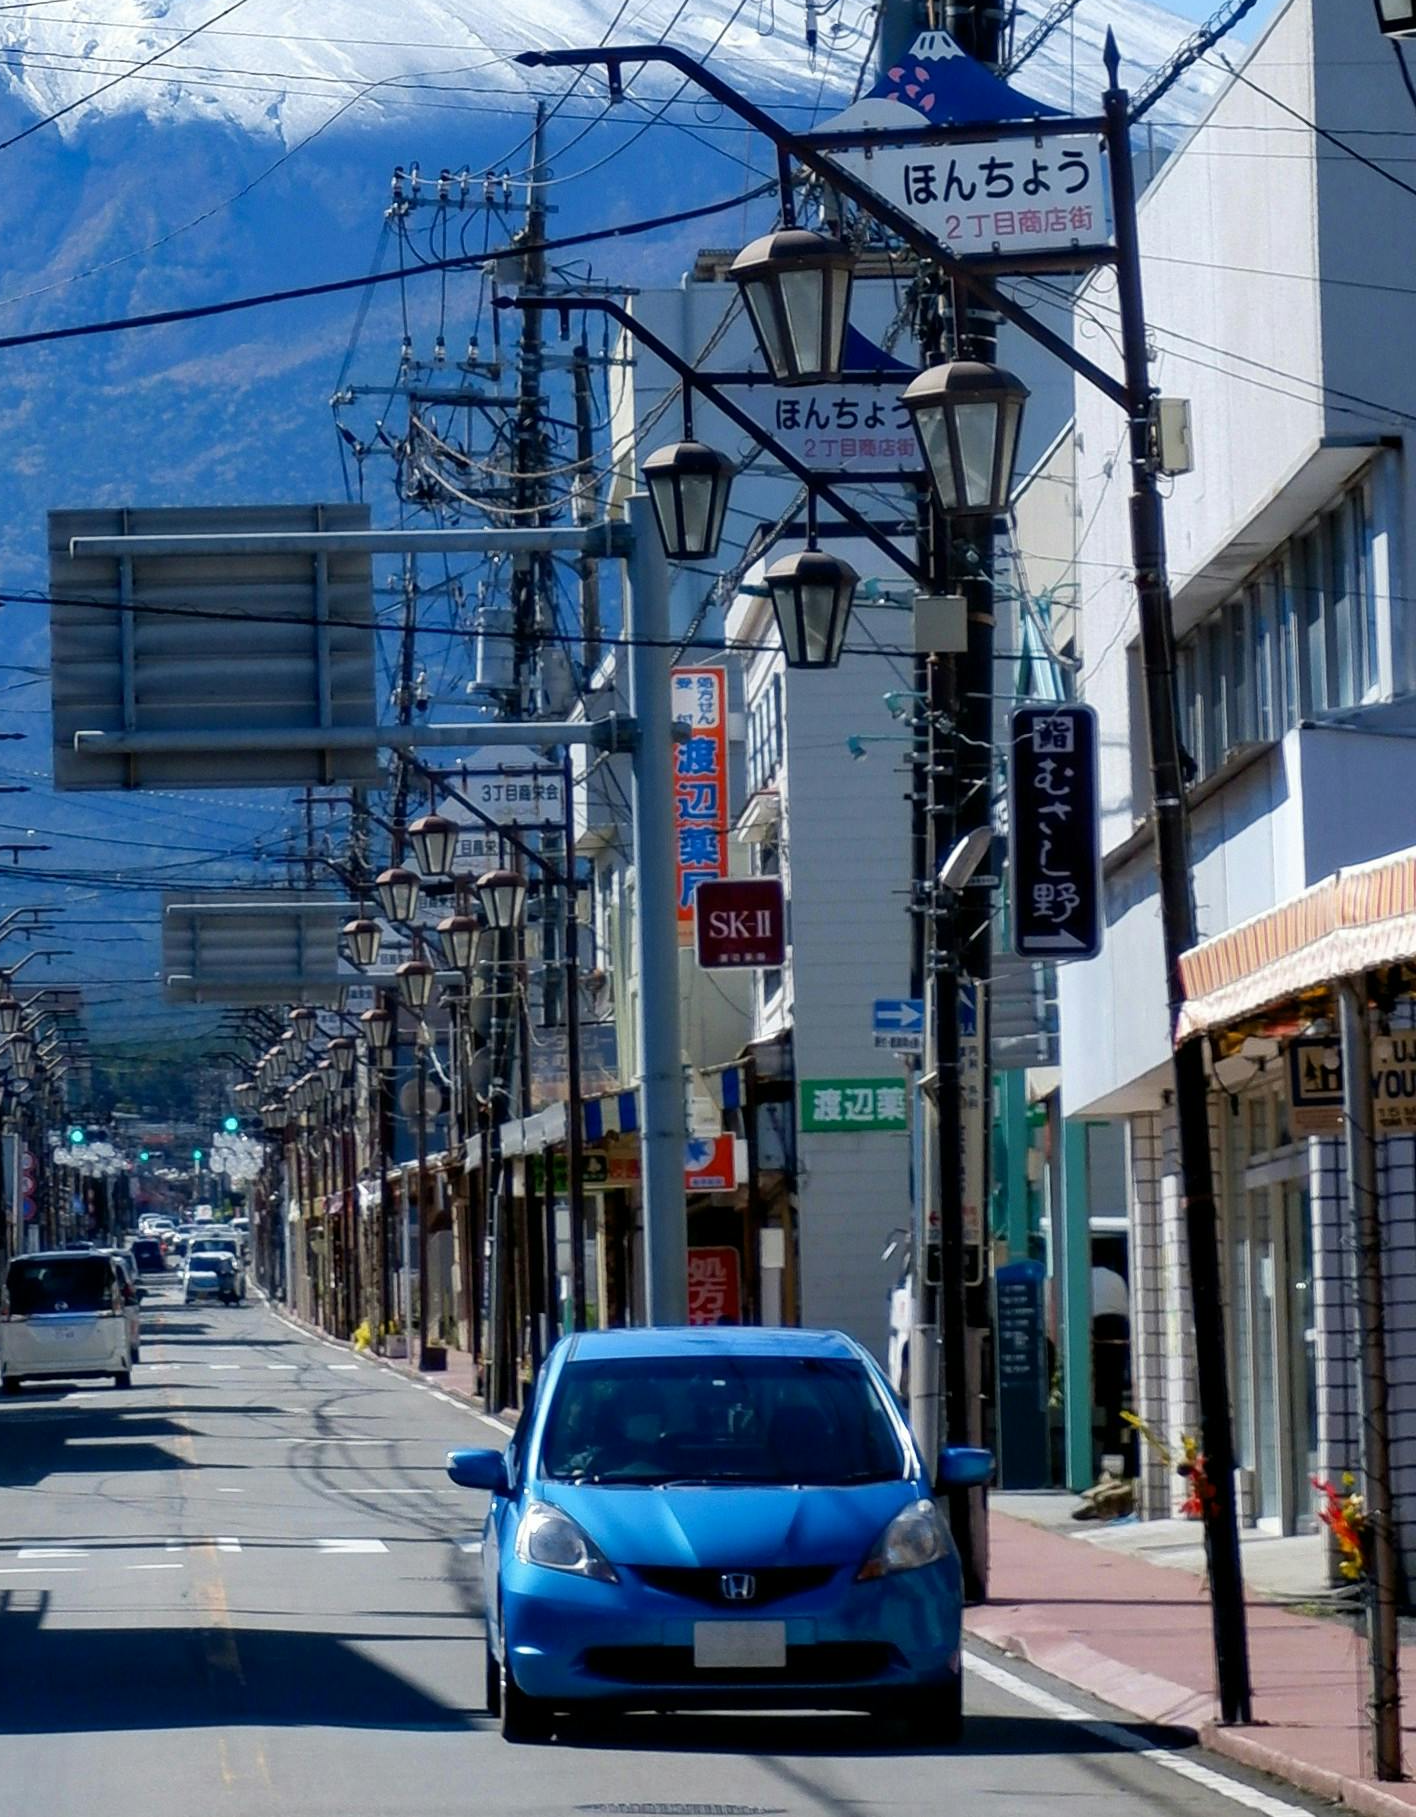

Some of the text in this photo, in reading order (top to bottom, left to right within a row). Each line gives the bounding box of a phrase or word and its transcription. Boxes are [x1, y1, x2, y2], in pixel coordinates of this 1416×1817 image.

[904, 150, 1090, 205] ほんちょう
[945, 205, 1093, 240] 2丁目商店街
[803, 437, 916, 458] 2丁目商店街
